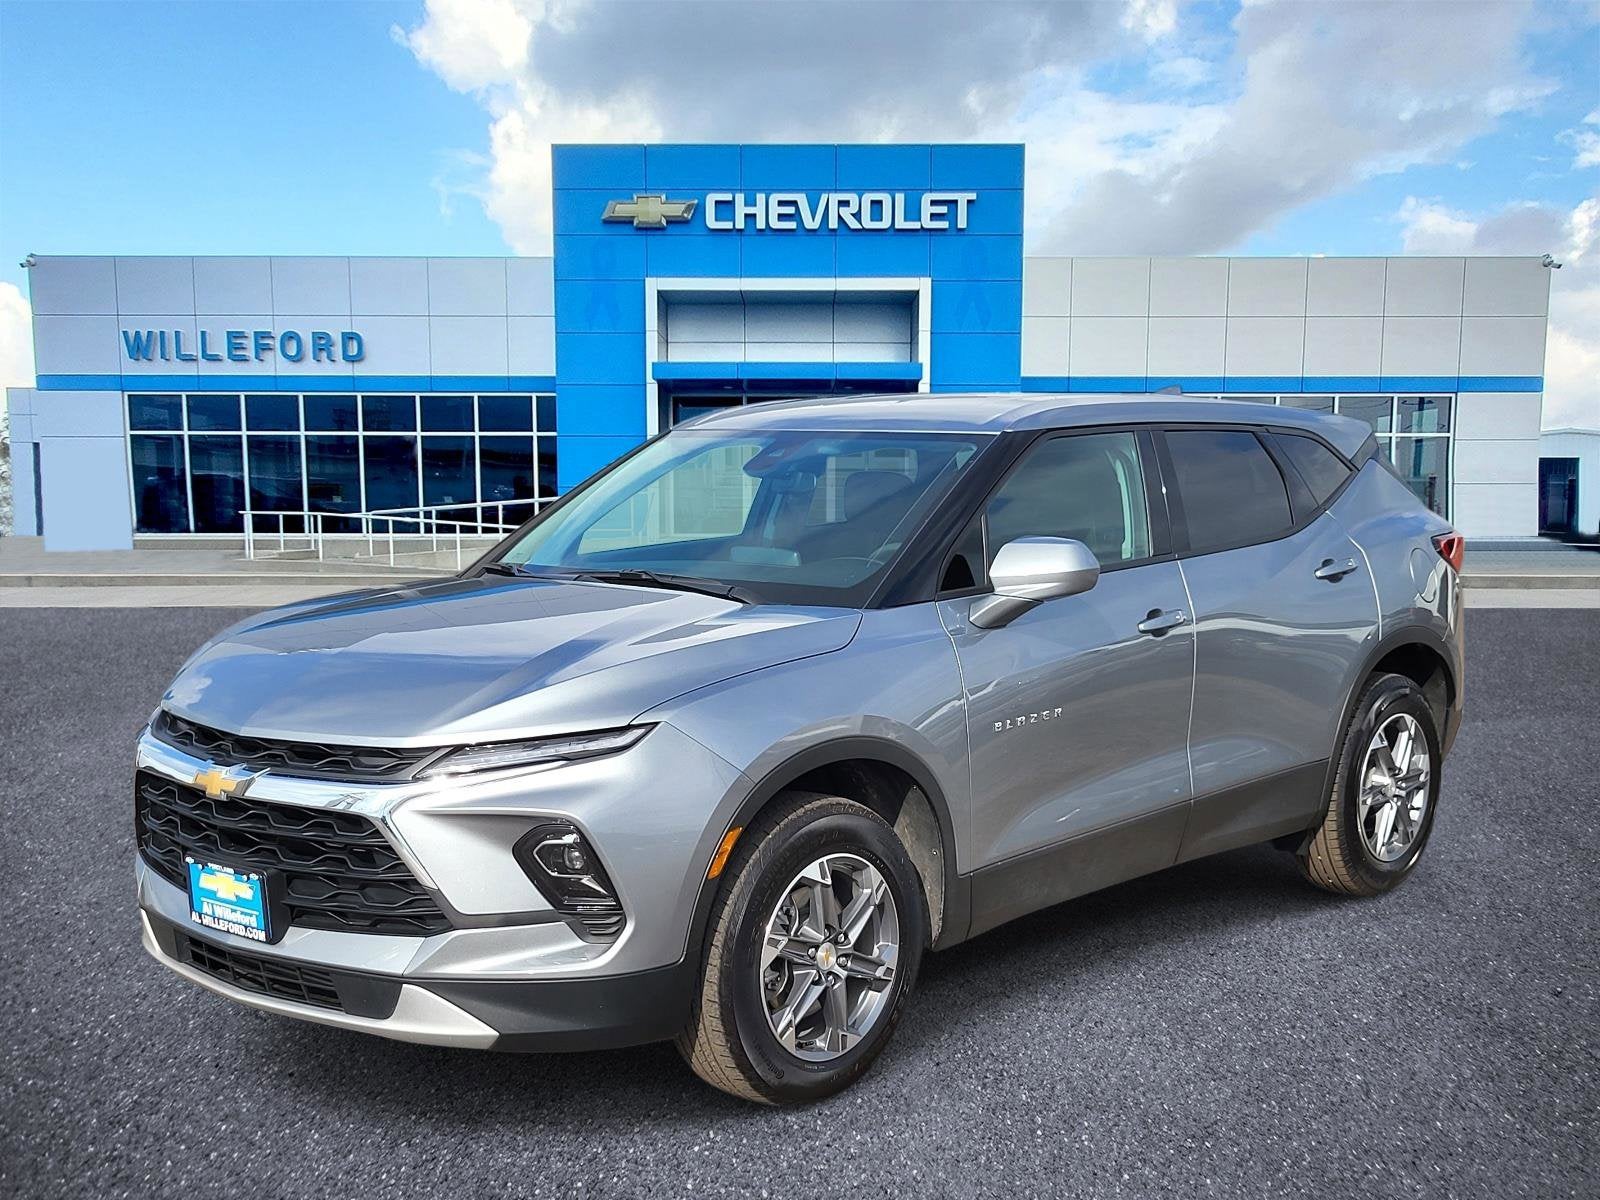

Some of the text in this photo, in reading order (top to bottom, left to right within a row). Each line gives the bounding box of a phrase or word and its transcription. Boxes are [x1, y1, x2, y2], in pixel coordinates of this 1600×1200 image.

[704, 192, 977, 230] CHEVROLET
[122, 330, 365, 362] WILLEFORD
[994, 707, 1062, 732] BLAZER
